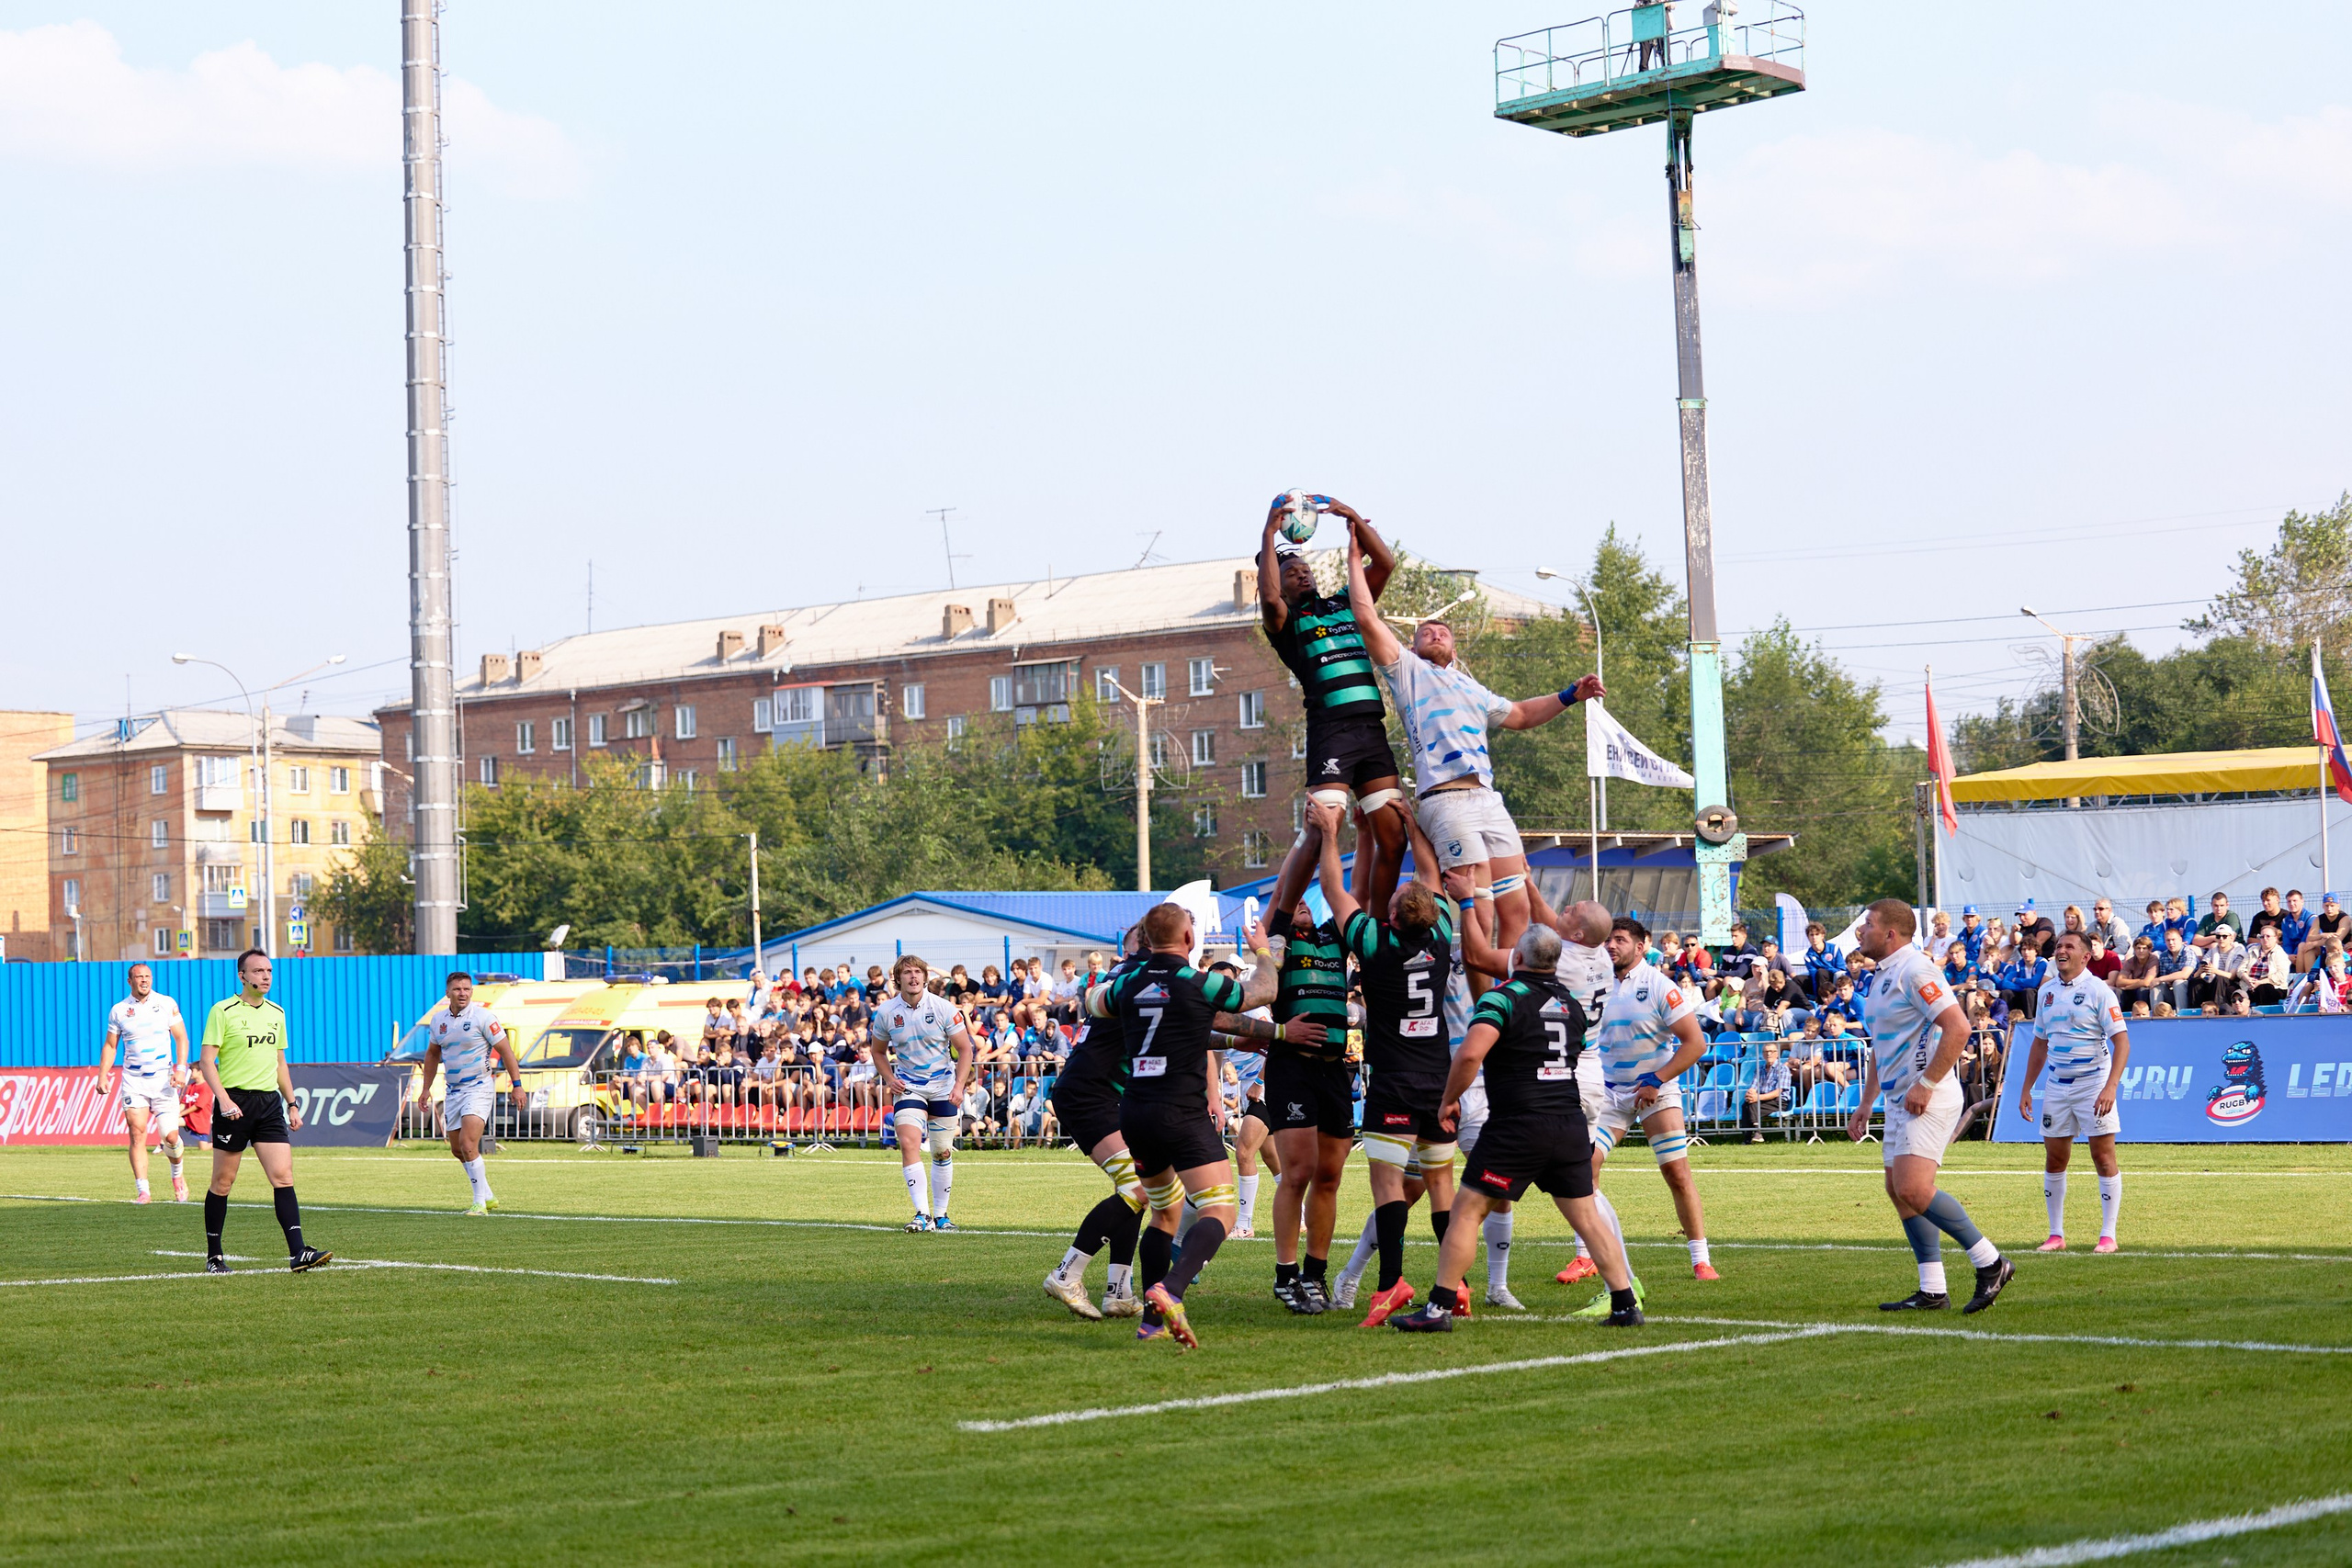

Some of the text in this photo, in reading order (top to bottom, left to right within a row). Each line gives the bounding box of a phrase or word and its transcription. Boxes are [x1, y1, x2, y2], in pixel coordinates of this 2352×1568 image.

[1408, 970, 1433, 1017] 5
[1138, 1007, 1163, 1055] 7
[1544, 1021, 1567, 1067] 3
